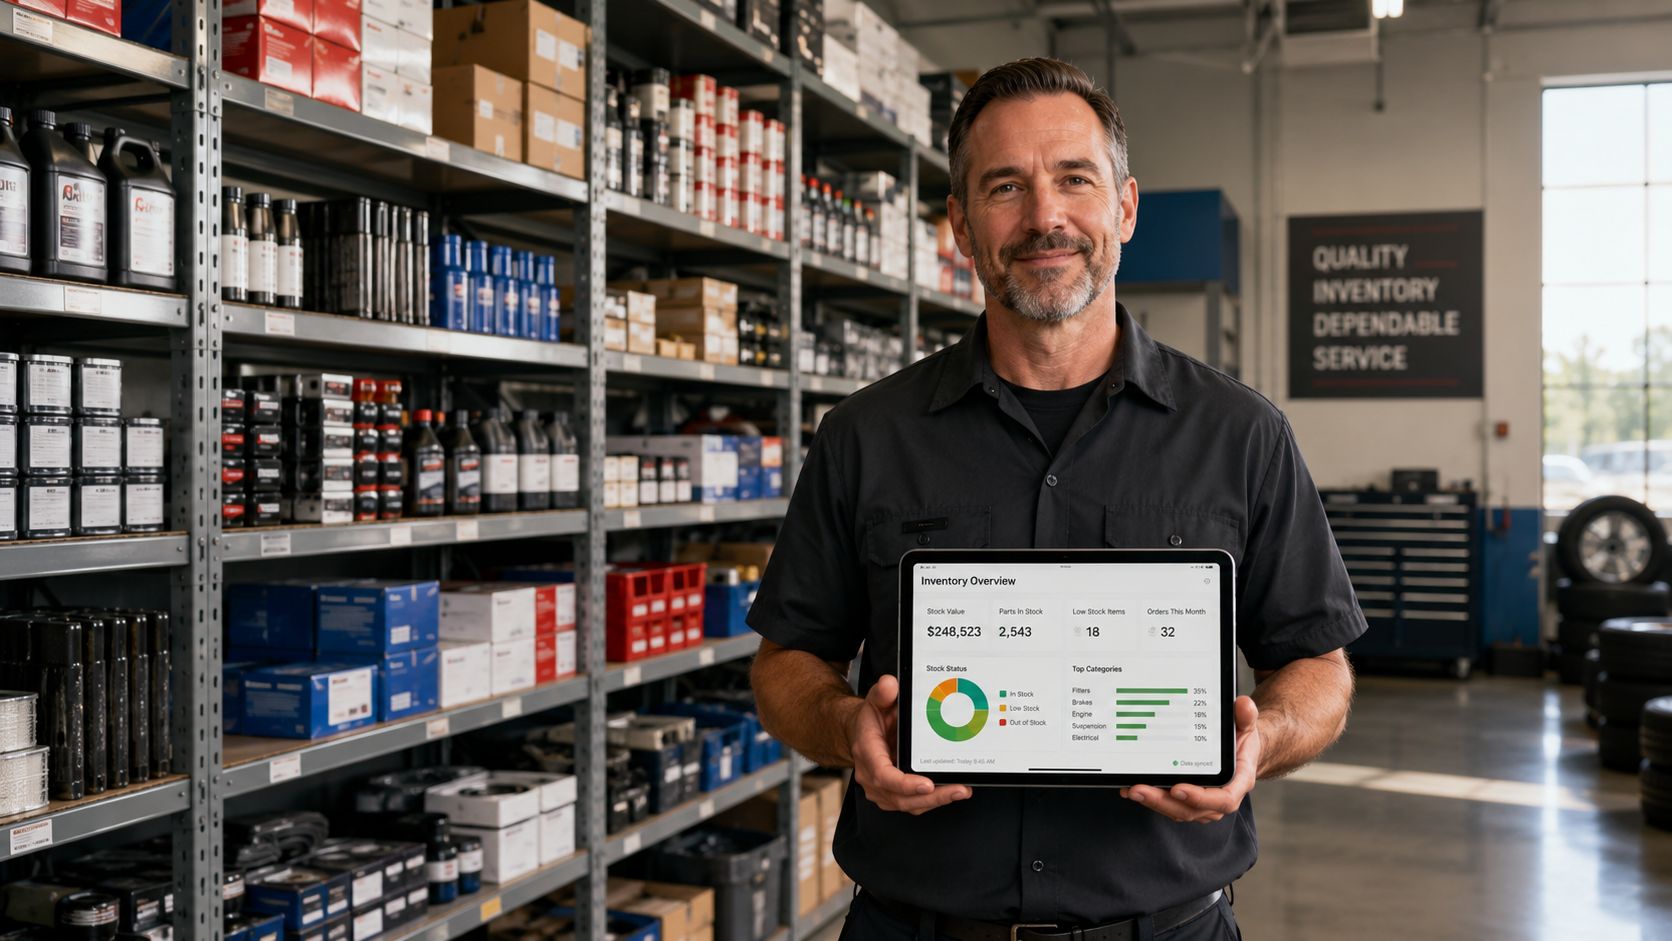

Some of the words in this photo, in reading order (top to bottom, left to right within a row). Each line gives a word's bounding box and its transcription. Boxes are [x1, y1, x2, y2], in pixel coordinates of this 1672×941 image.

[1313, 244, 1409, 272] QUALITY
[1313, 277, 1439, 303] INVENTORY
[1313, 310, 1460, 337] DEPENDABLE
[1313, 345, 1407, 370] SERVICE
[921, 576, 968, 587] Inventory
[970, 576, 1016, 586] Overview
[927, 626, 982, 638] $248,523
[999, 626, 1032, 638] 2,543
[1086, 626, 1100, 637] 18
[1160, 626, 1175, 637] 32
[1072, 665, 1085, 673] Top
[1086, 665, 1122, 673] Categories
